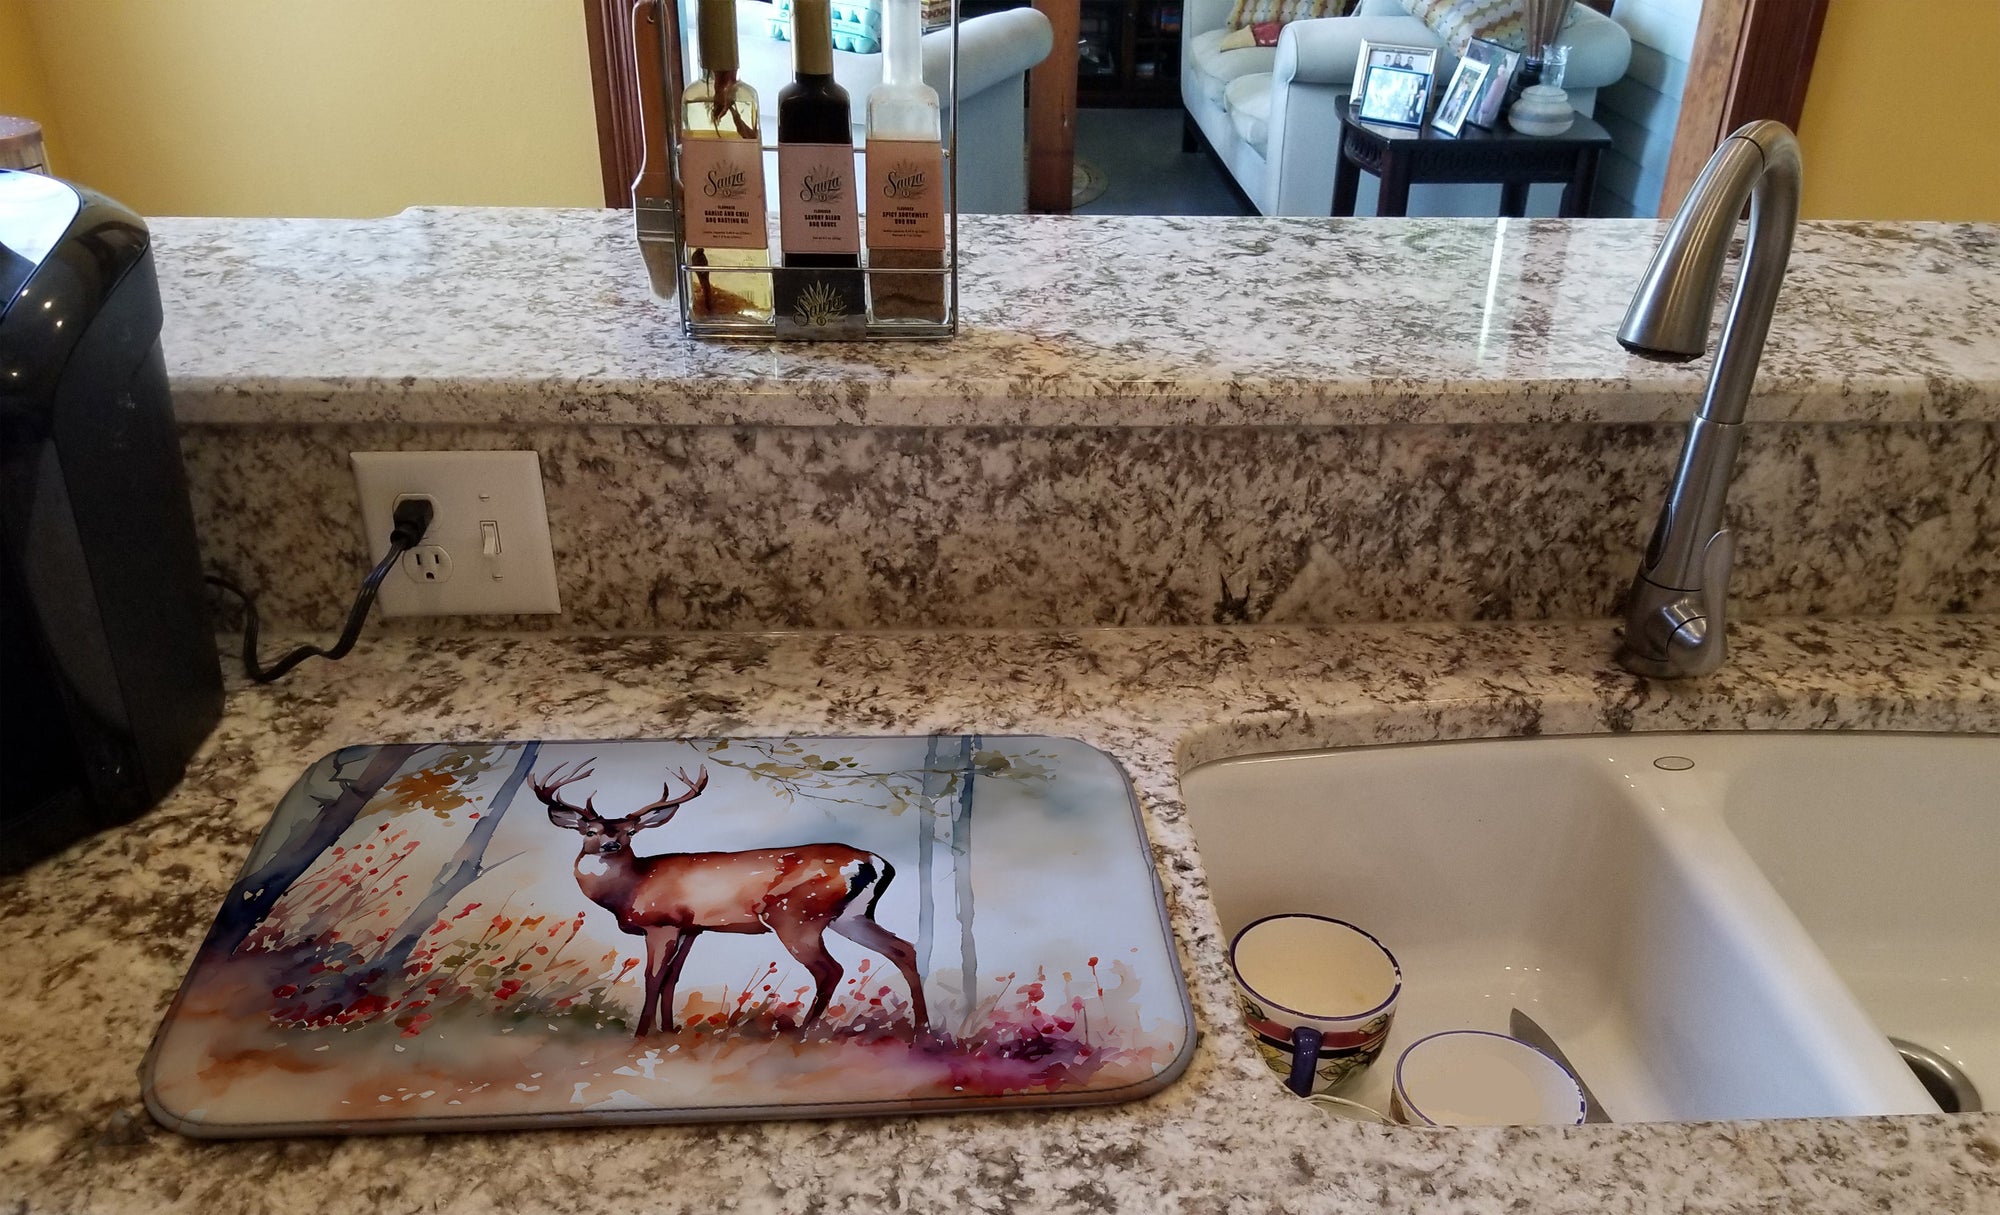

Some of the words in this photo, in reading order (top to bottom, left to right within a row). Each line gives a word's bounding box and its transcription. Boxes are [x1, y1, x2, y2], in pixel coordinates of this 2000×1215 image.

[704, 170, 746, 197] Sauza
[800, 175, 842, 202] Sauza
[884, 170, 926, 197] Sauza
